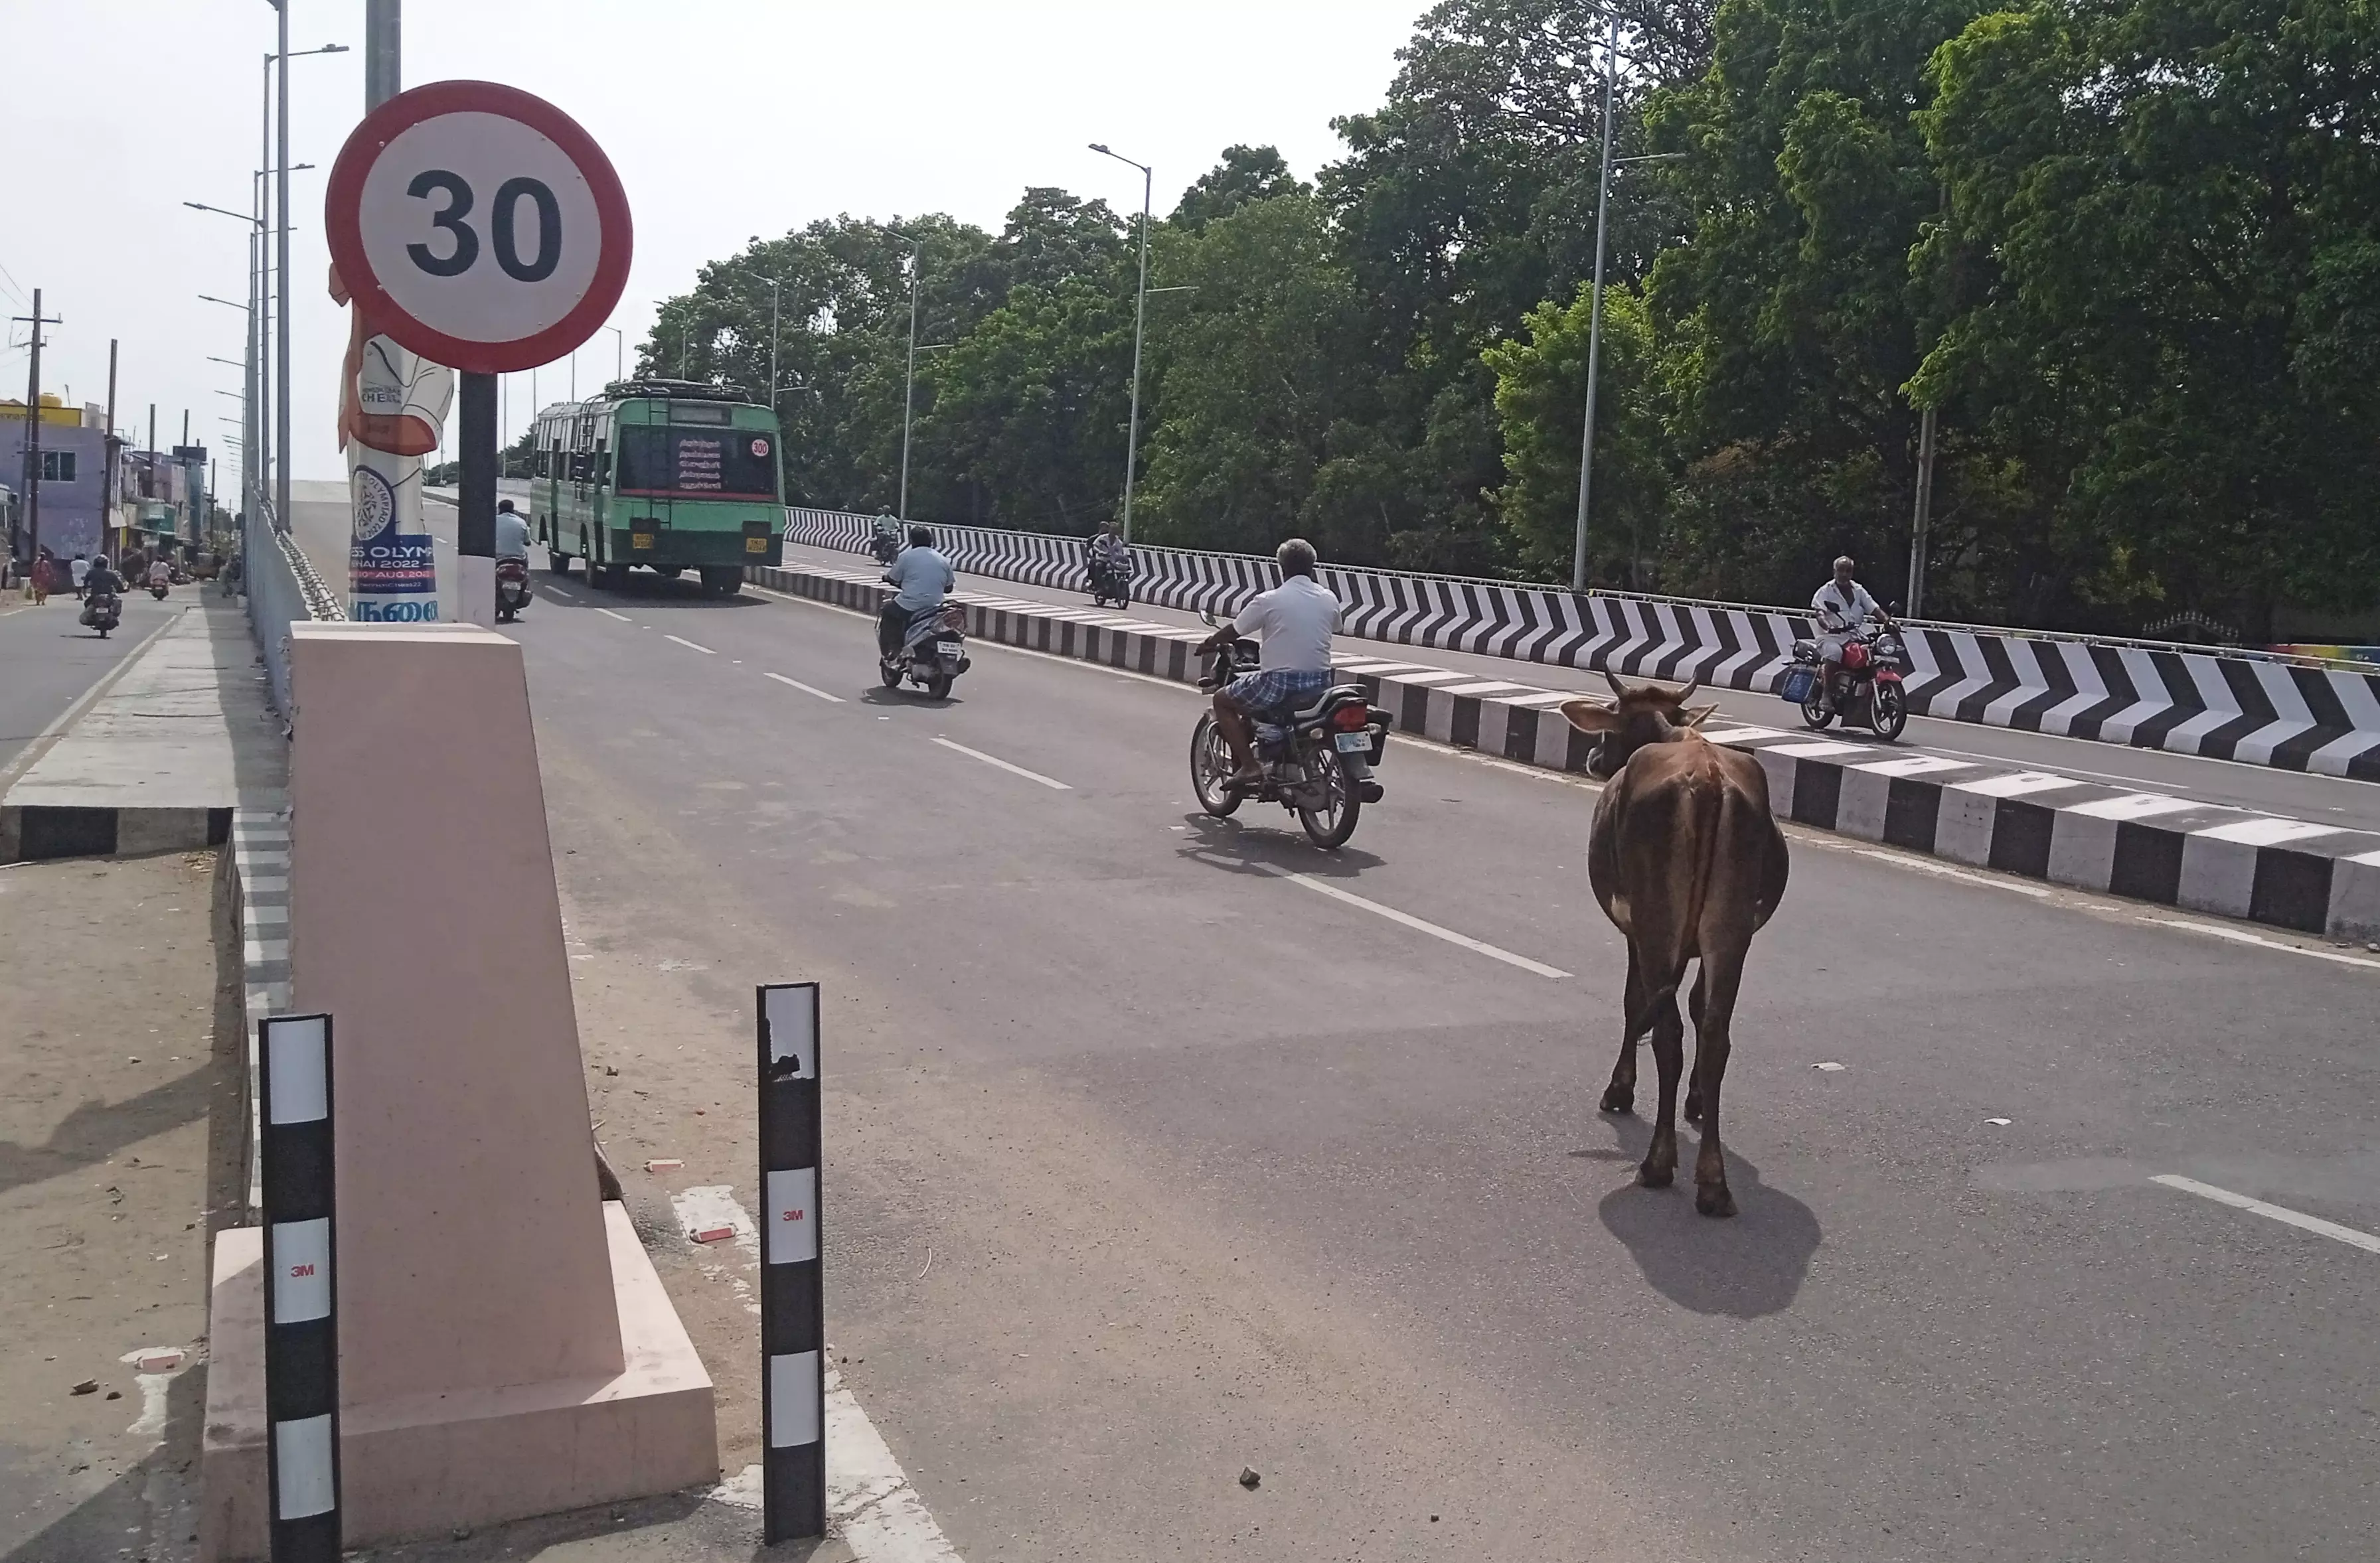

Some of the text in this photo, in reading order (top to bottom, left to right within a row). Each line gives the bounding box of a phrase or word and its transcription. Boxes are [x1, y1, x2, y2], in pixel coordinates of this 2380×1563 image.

[406, 169, 562, 283] 30
[754, 442, 767, 454] 300
[380, 559, 420, 569] 2022
[783, 1209, 804, 1222] 3M
[290, 1263, 315, 1278] 3M
